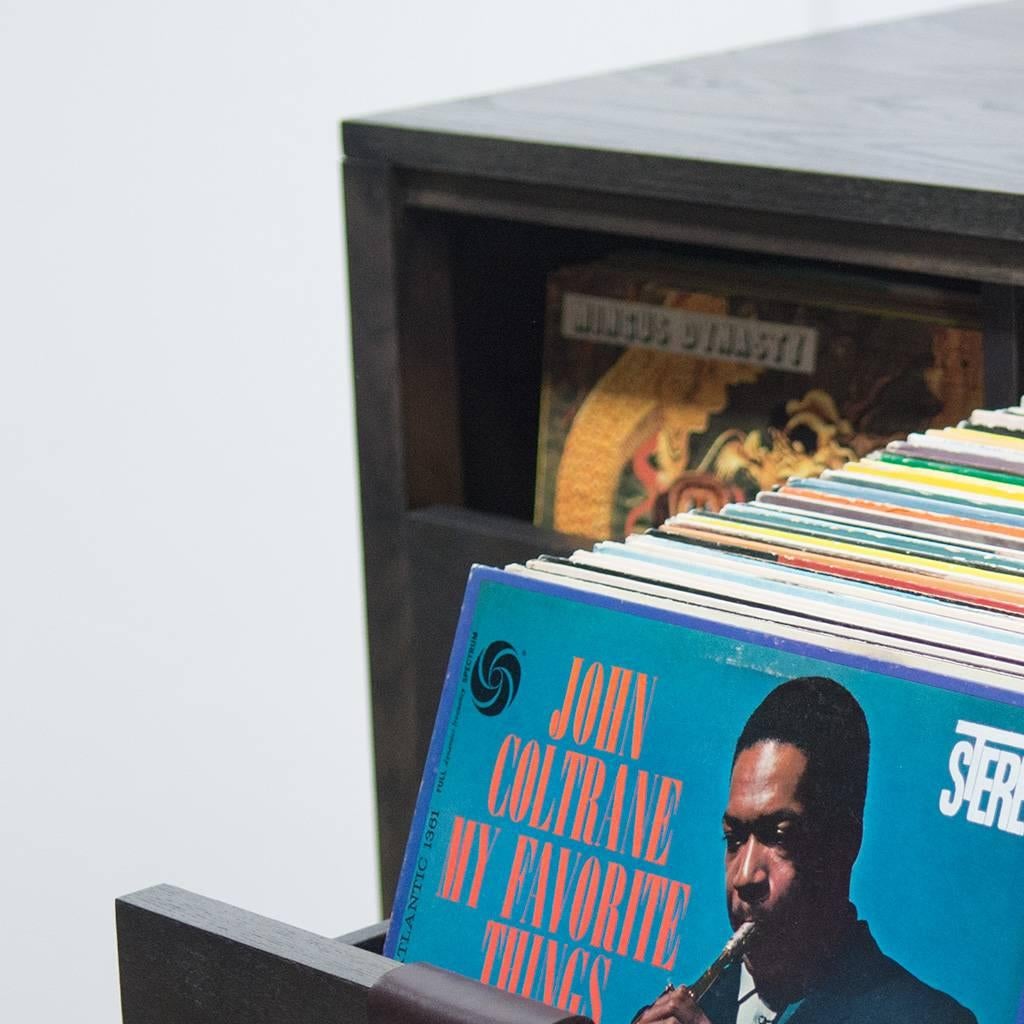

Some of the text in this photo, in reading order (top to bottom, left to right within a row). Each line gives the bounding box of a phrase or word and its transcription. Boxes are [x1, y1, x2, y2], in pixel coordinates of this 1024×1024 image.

[681, 319, 806, 367] DYNASTY
[463, 631, 478, 683] SPECTRUM
[548, 656, 658, 760] JOHN
[487, 734, 683, 865] COLTRANE
[396, 810, 440, 963] TLANTIC 1361
[436, 816, 692, 972] MY FAVORITE
